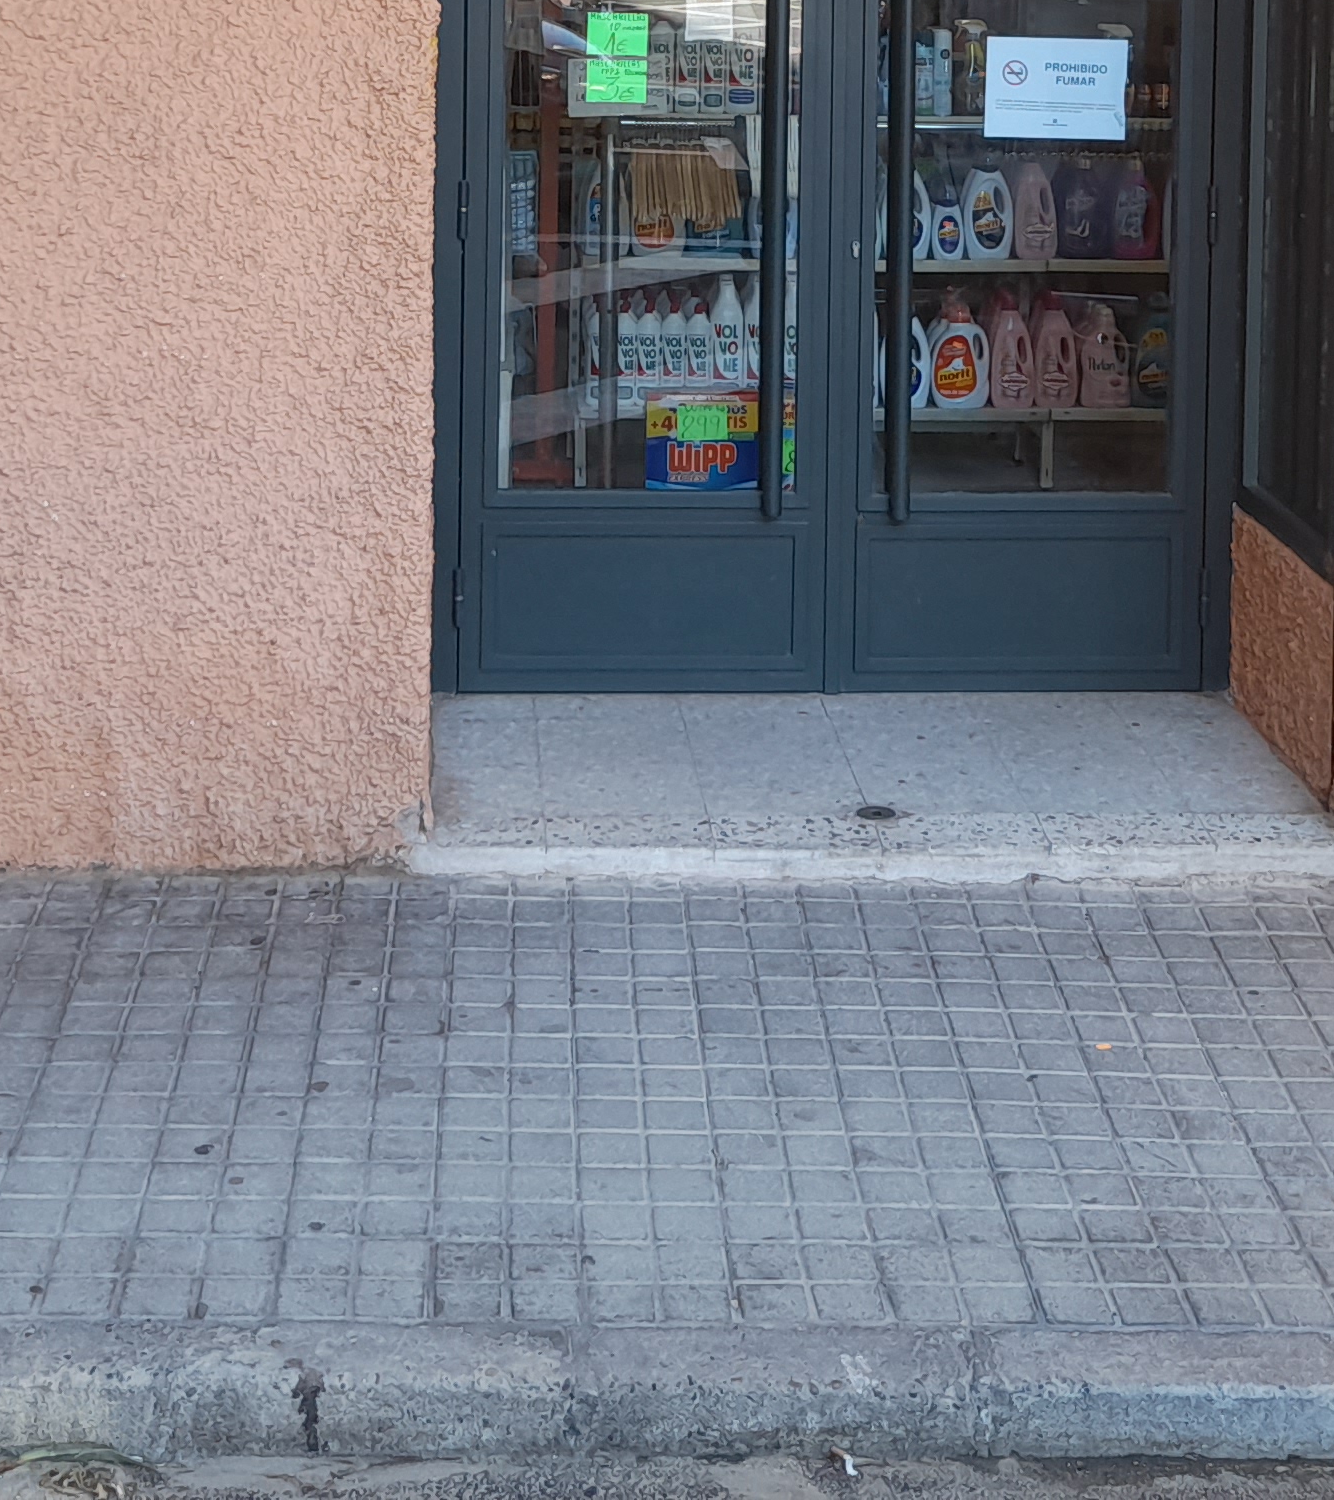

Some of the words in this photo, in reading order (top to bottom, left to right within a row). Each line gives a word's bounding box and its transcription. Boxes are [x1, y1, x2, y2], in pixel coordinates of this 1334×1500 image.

[1045, 62, 1108, 74] PROHIBIDO
[1055, 76, 1096, 86] FUMAR
[714, 324, 738, 338] VOL
[718, 341, 739, 355] VO
[939, 368, 971, 382] norit
